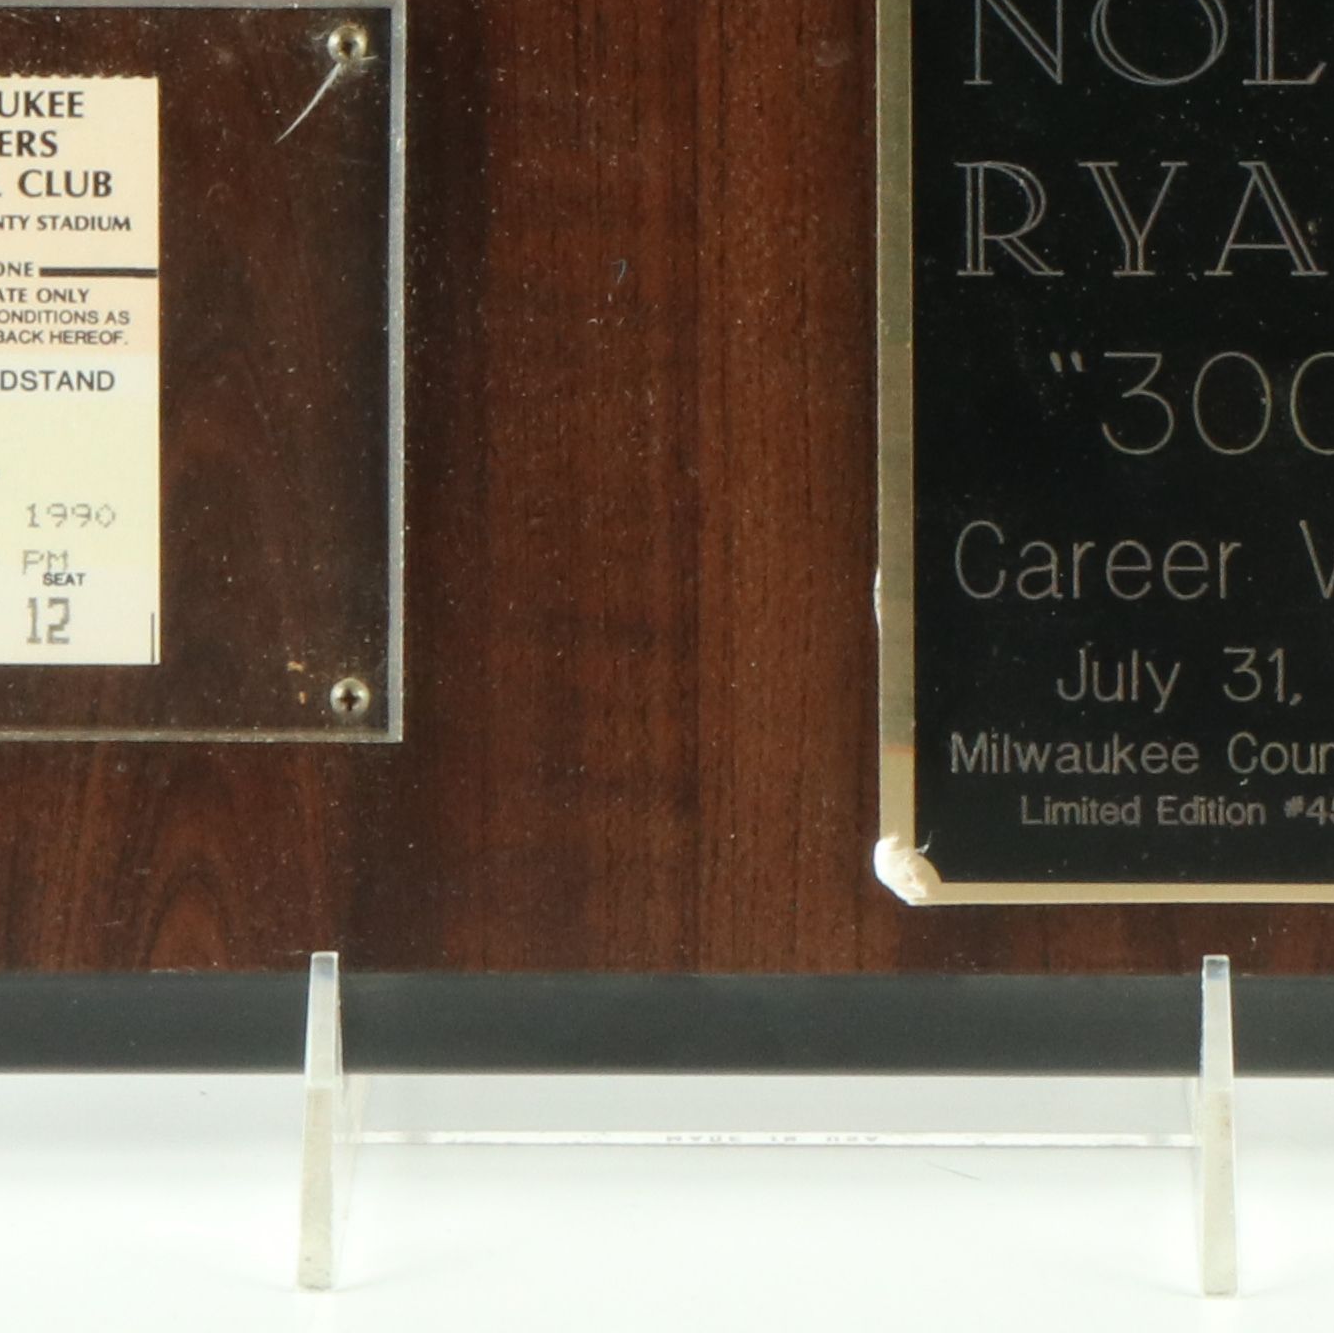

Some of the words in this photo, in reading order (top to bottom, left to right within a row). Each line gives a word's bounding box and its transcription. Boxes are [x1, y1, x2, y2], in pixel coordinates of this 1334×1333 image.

[18, 170, 113, 197] CLUB
[37, 215, 132, 232] STADIUM
[36, 288, 90, 303] ONLY
[106, 311, 130, 325] AS
[49, 330, 129, 345] HEREOF.
[26, 503, 116, 528] 1990
[22, 549, 68, 574] PM
[954, 519, 1241, 601] Career
[42, 572, 86, 587] SEAT
[26, 597, 70, 644] 12
[1057, 643, 1181, 714] July
[1222, 648, 1303, 705] 31,
[950, 733, 1200, 774] Milwaukee
[1021, 796, 1141, 826] Limited
[1157, 796, 1266, 826] Edition
